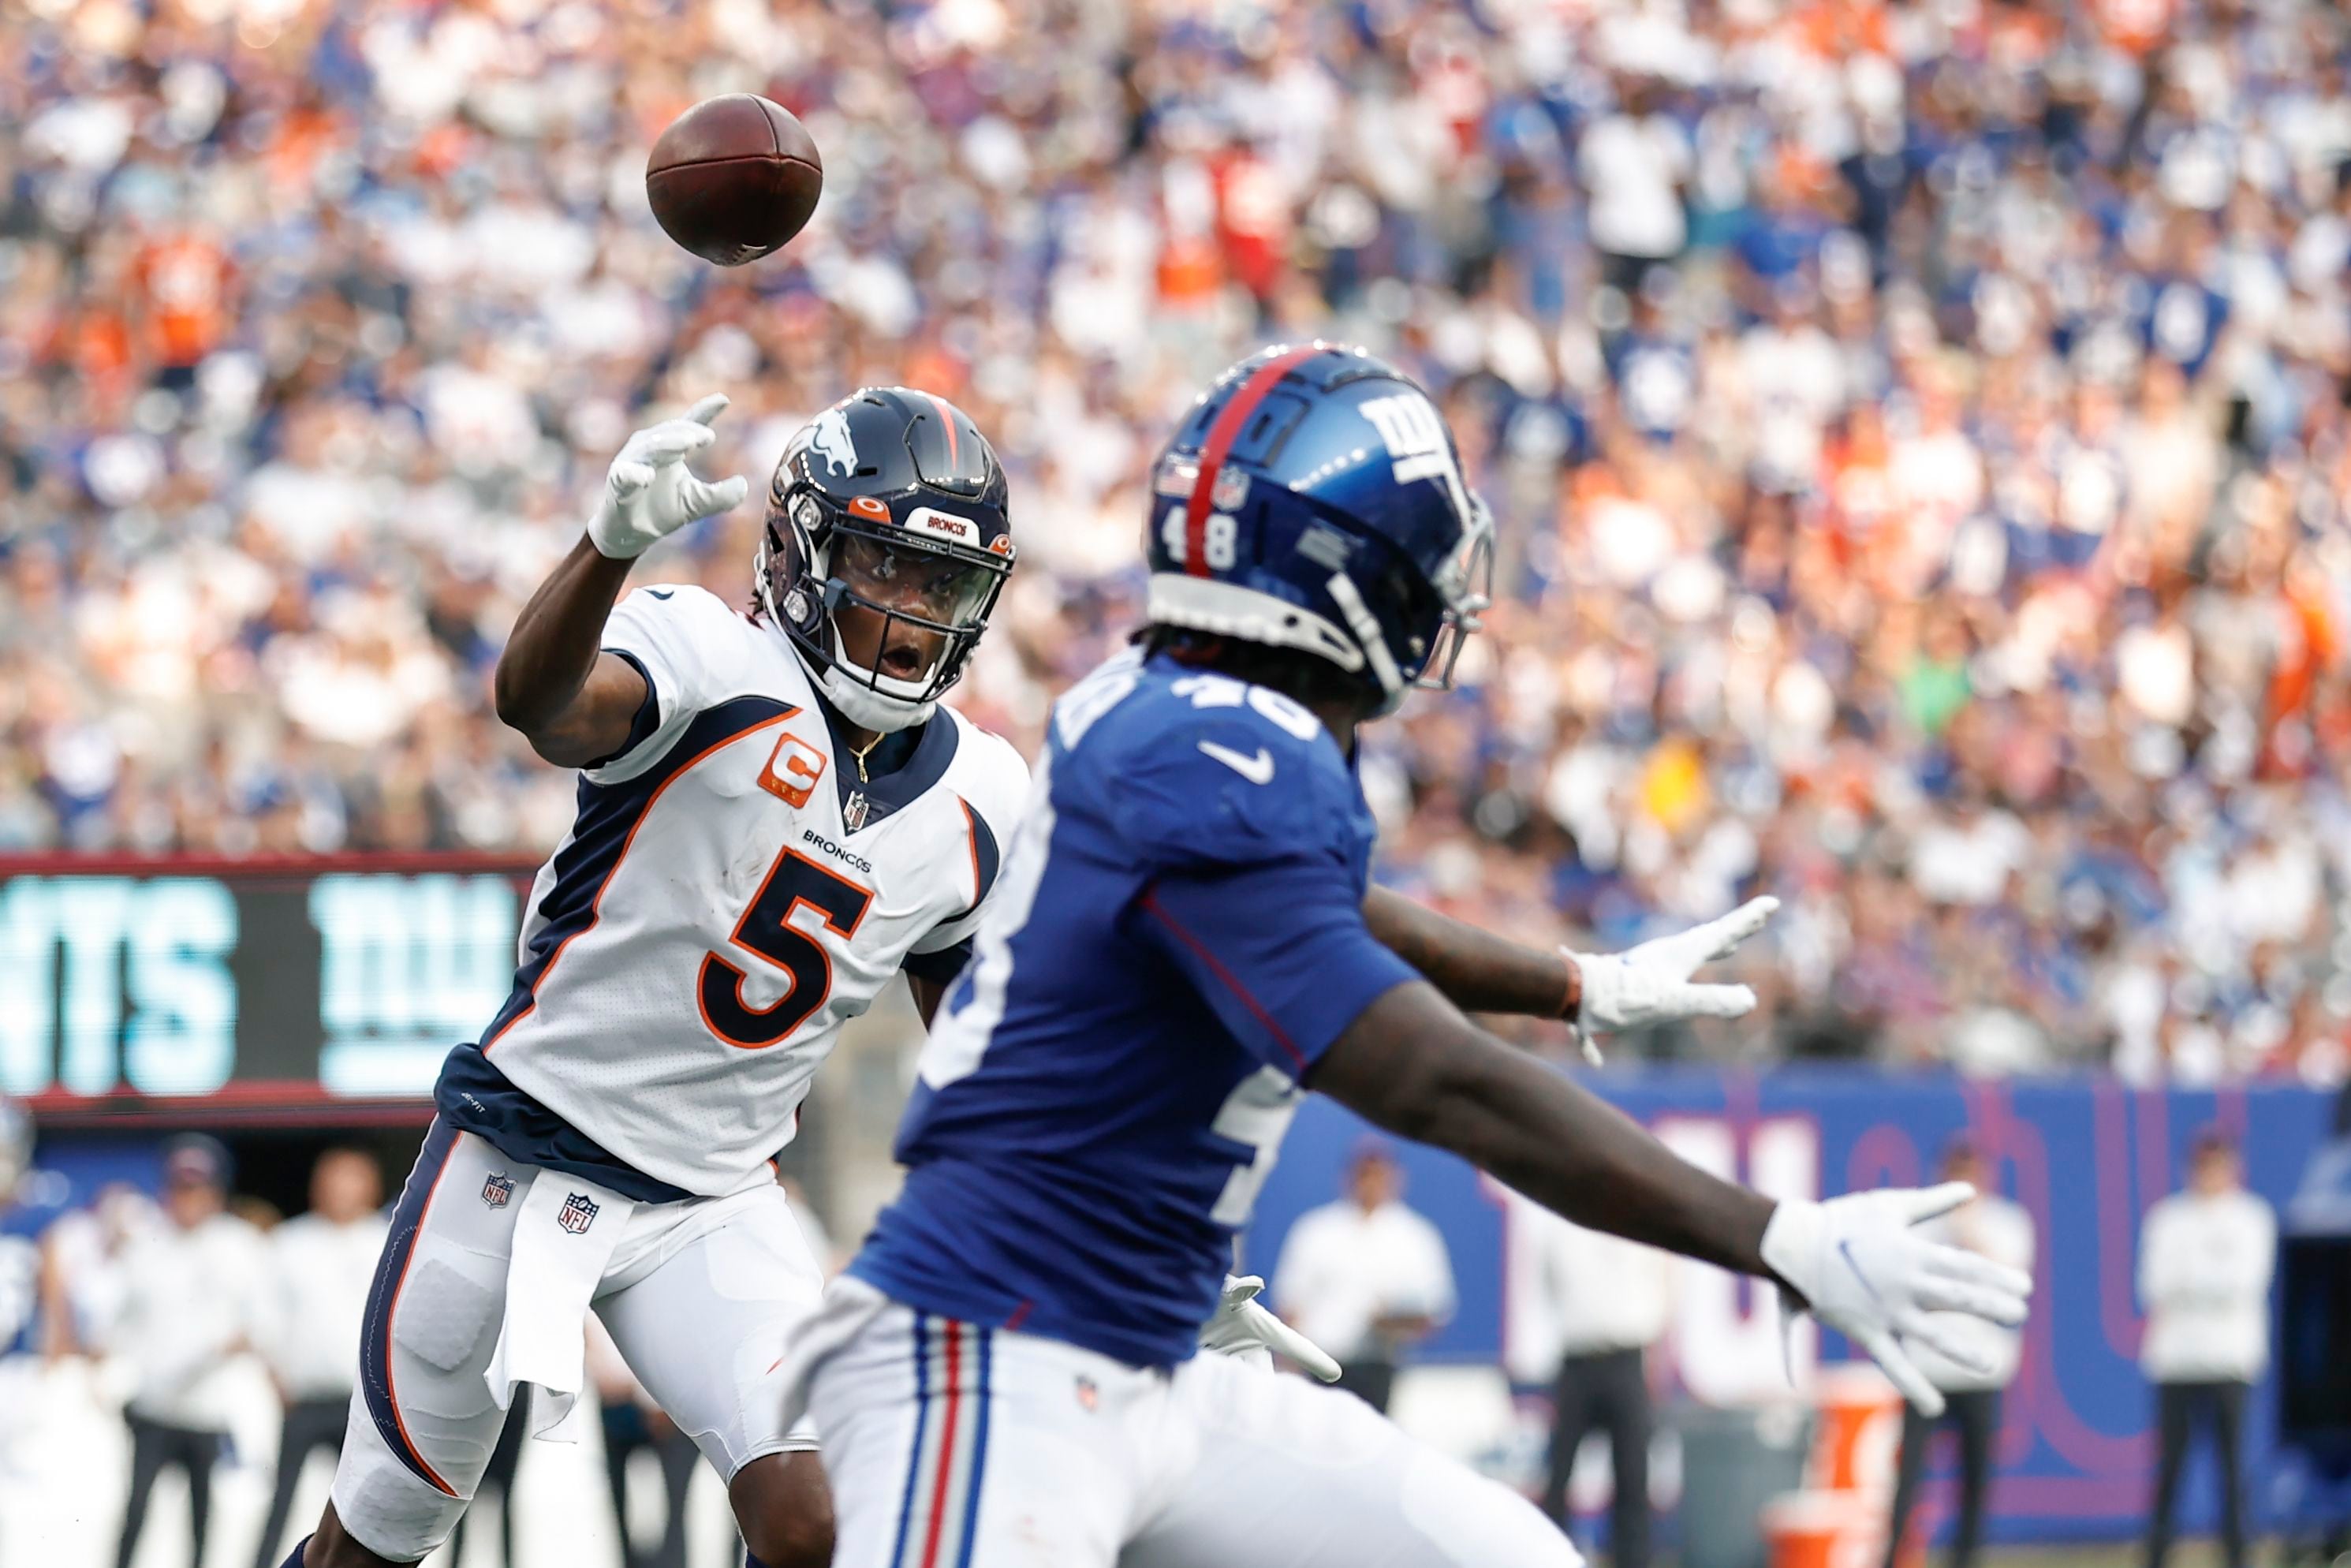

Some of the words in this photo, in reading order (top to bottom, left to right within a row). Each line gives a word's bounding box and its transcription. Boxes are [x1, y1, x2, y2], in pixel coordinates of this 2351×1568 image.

[927, 516, 967, 536] BRONCOS
[1162, 506, 1238, 570] 48
[803, 829, 872, 873] BRONCOS
[696, 845, 875, 1049] 5
[486, 1185, 506, 1204] NFL
[561, 1206, 589, 1232] NFL
